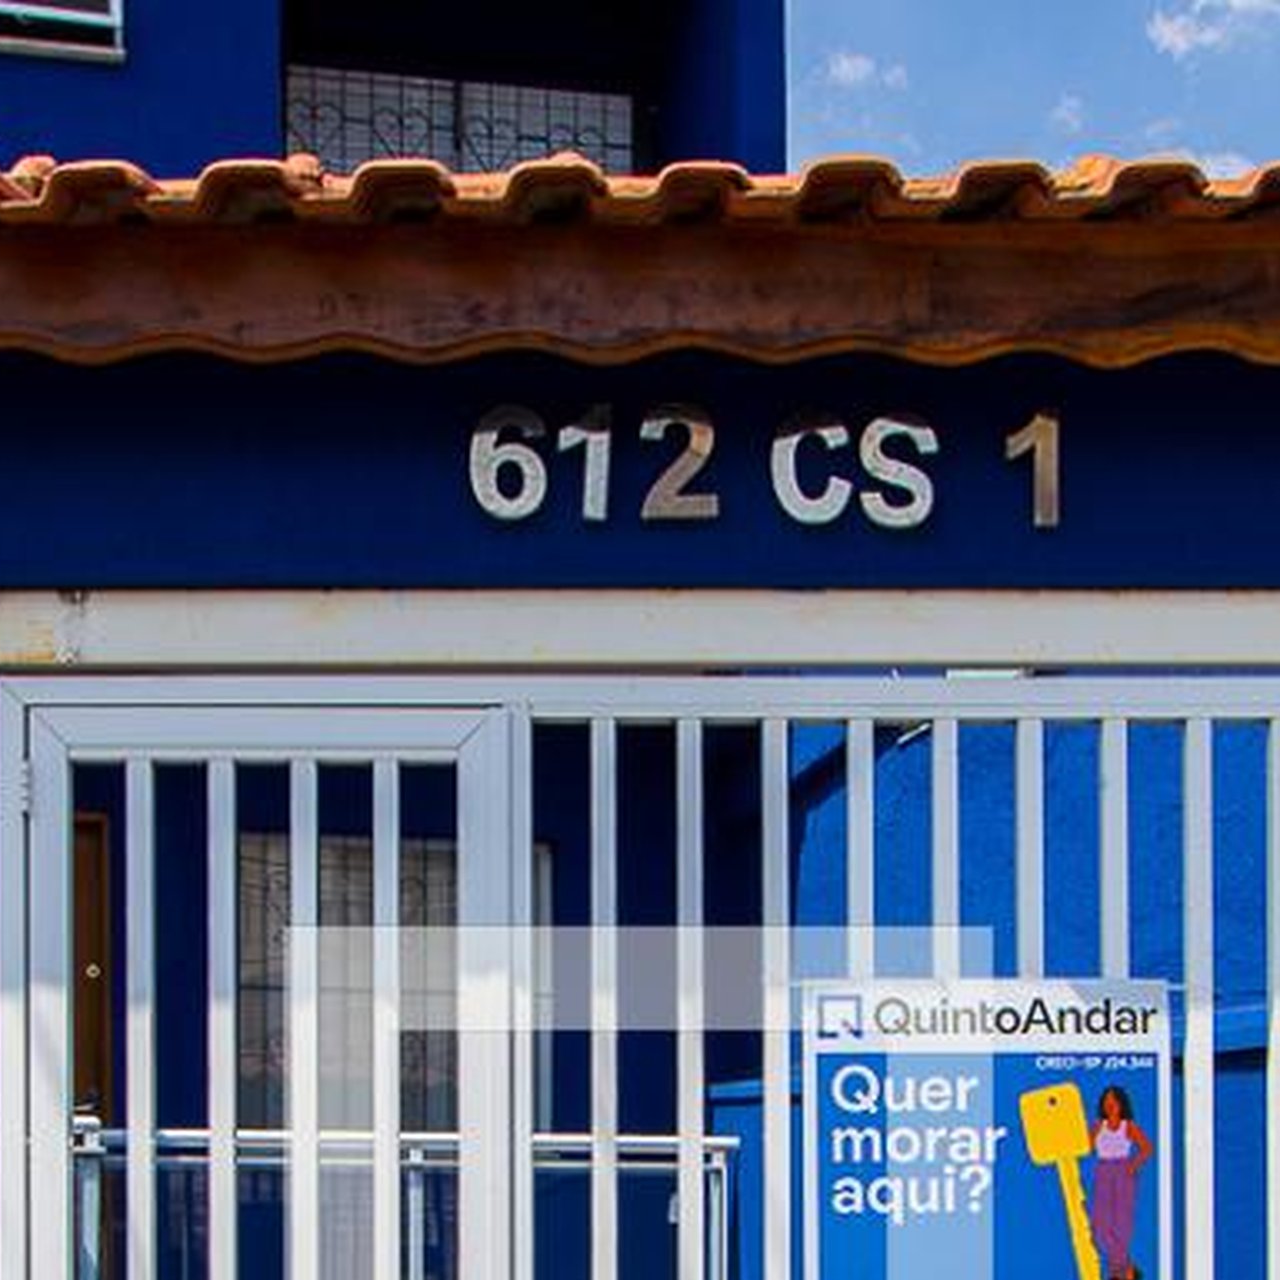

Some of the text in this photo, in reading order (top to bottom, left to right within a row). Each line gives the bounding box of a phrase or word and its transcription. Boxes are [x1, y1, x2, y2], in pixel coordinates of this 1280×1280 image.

[468, 402, 1060, 527] 612 CS 1
[874, 997, 1158, 1036] QuintoAndar
[831, 1064, 979, 1114] Quer
[831, 1126, 1008, 1163] morar
[832, 1164, 992, 1226] aqui?
